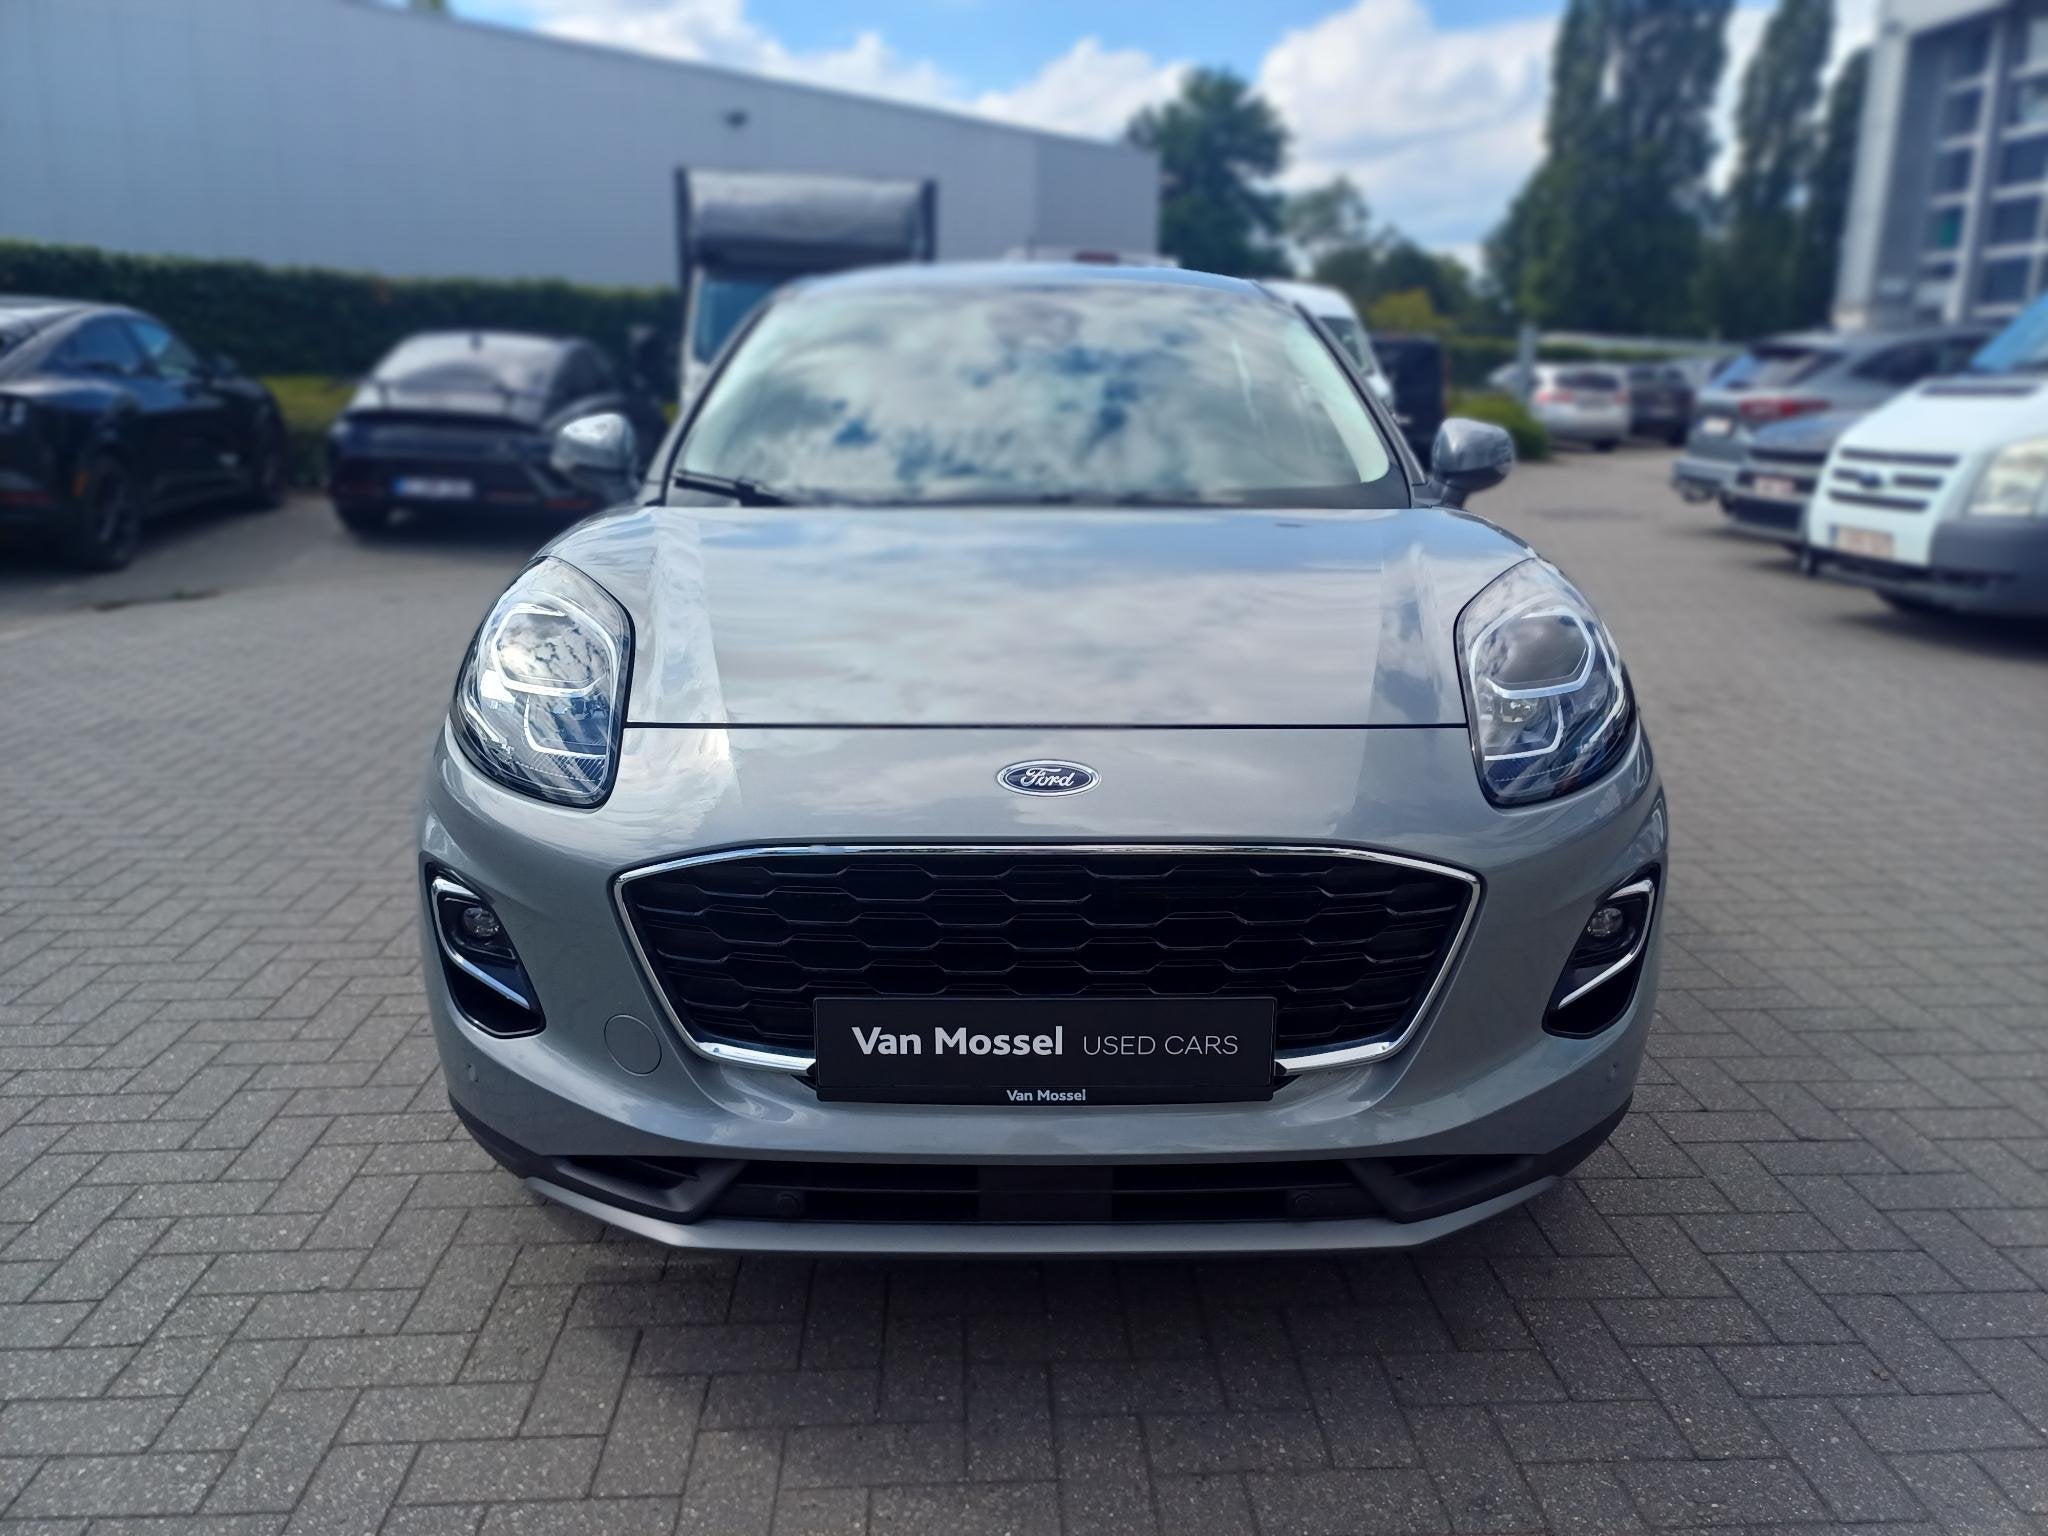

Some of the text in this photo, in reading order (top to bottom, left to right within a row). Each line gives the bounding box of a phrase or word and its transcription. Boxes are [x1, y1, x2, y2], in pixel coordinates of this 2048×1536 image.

[1020, 767, 1076, 787] Ford
[851, 1025, 1238, 1056] Van Mossel USED CARS
[1006, 1088, 1087, 1101] Van Mossel
